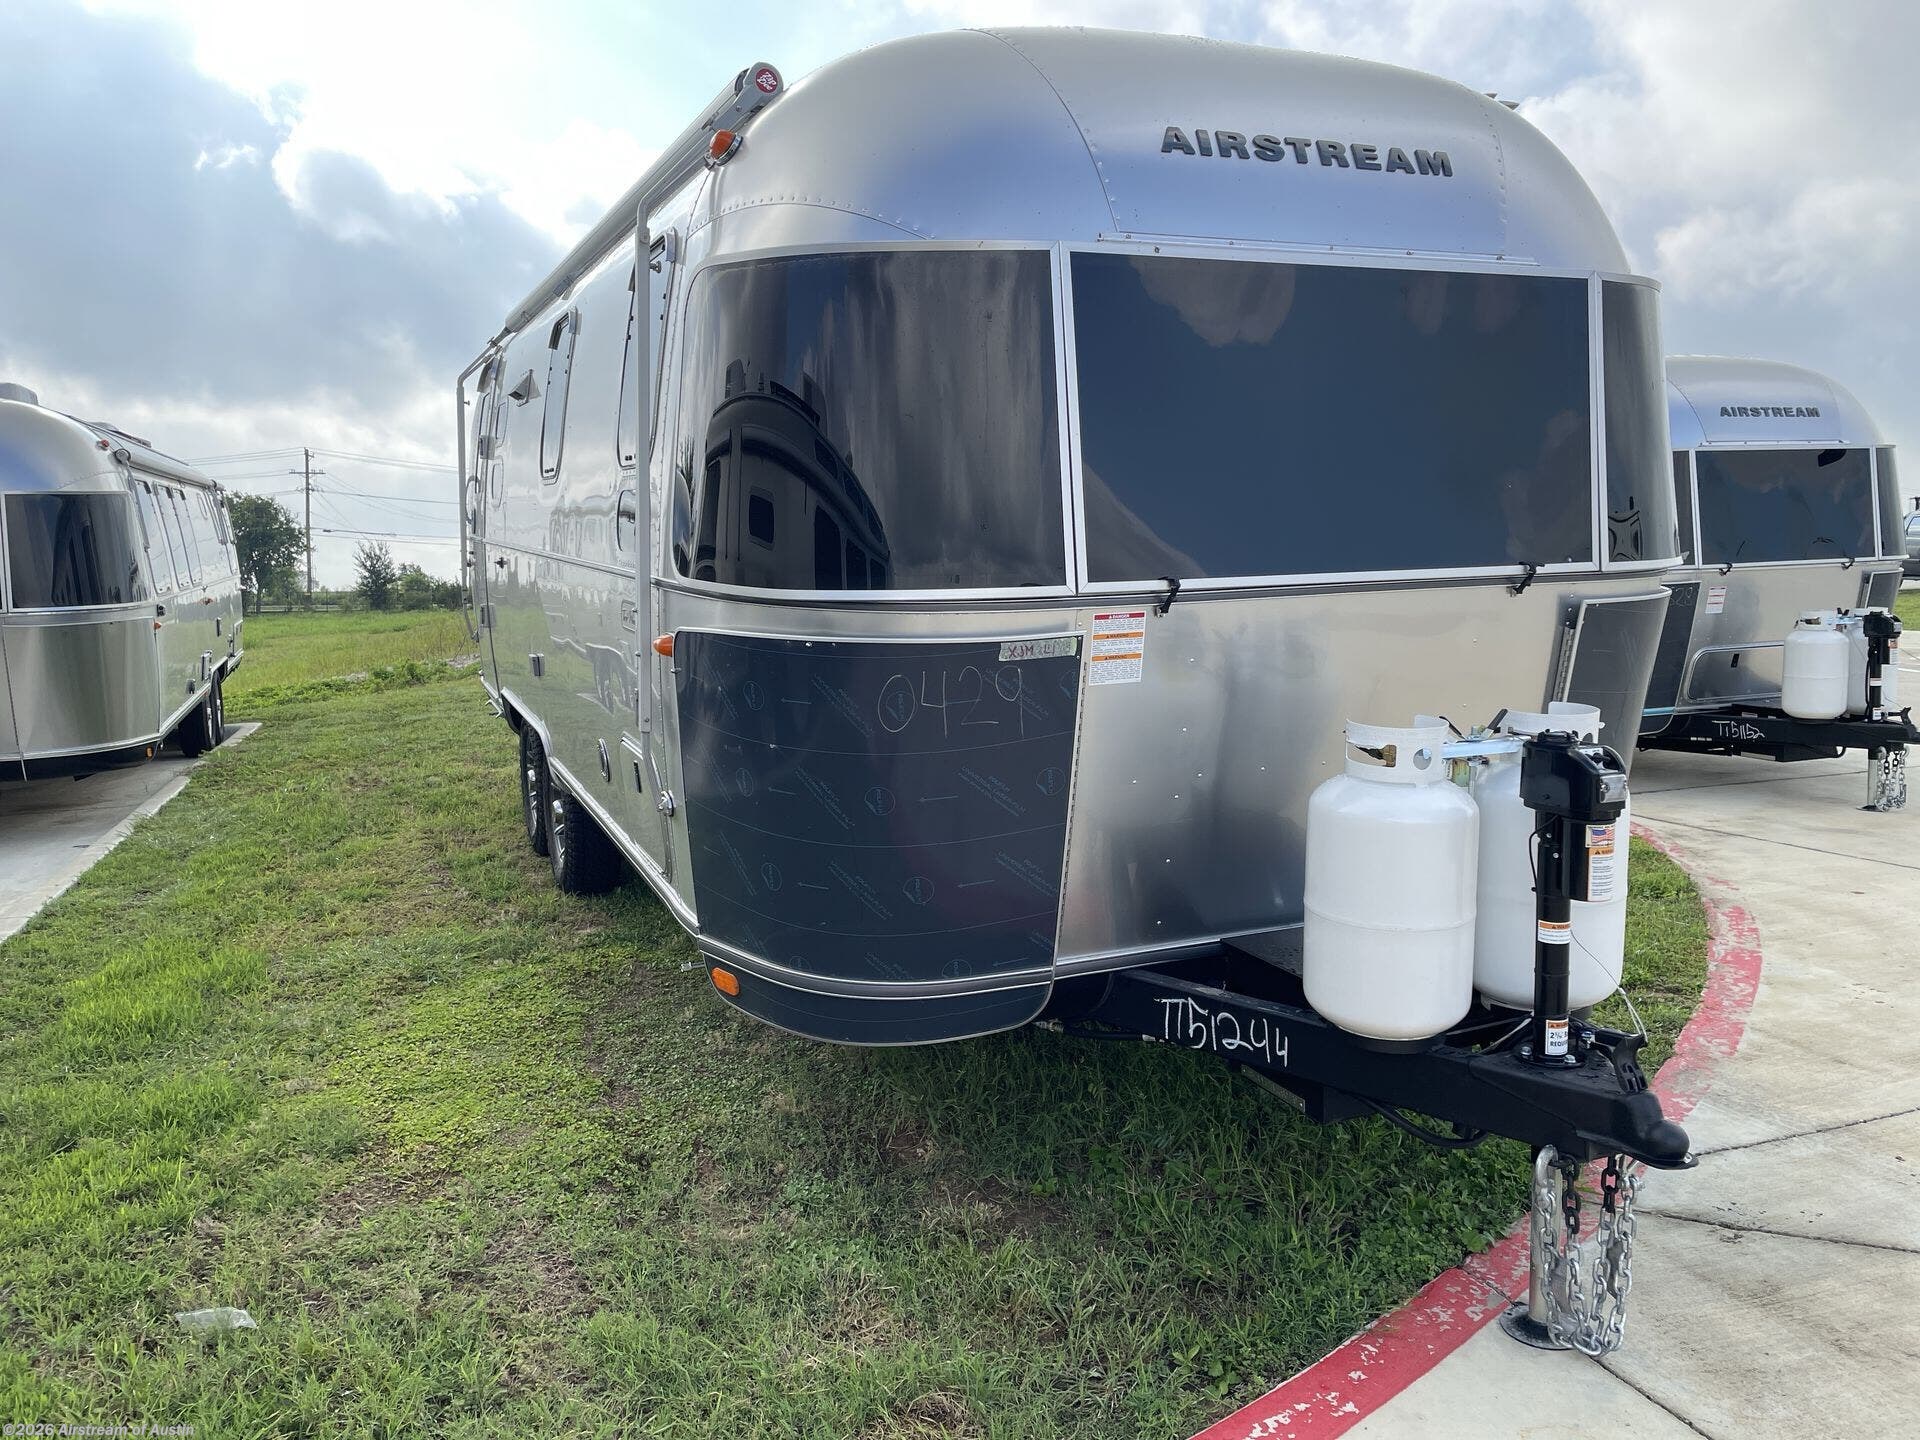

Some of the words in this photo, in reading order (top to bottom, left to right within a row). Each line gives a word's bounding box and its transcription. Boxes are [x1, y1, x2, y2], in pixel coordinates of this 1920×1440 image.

[1161, 126, 1453, 177] AIRSTREAM
[1720, 406, 1820, 418] AIRSTREAM
[878, 665, 1024, 739] 0429
